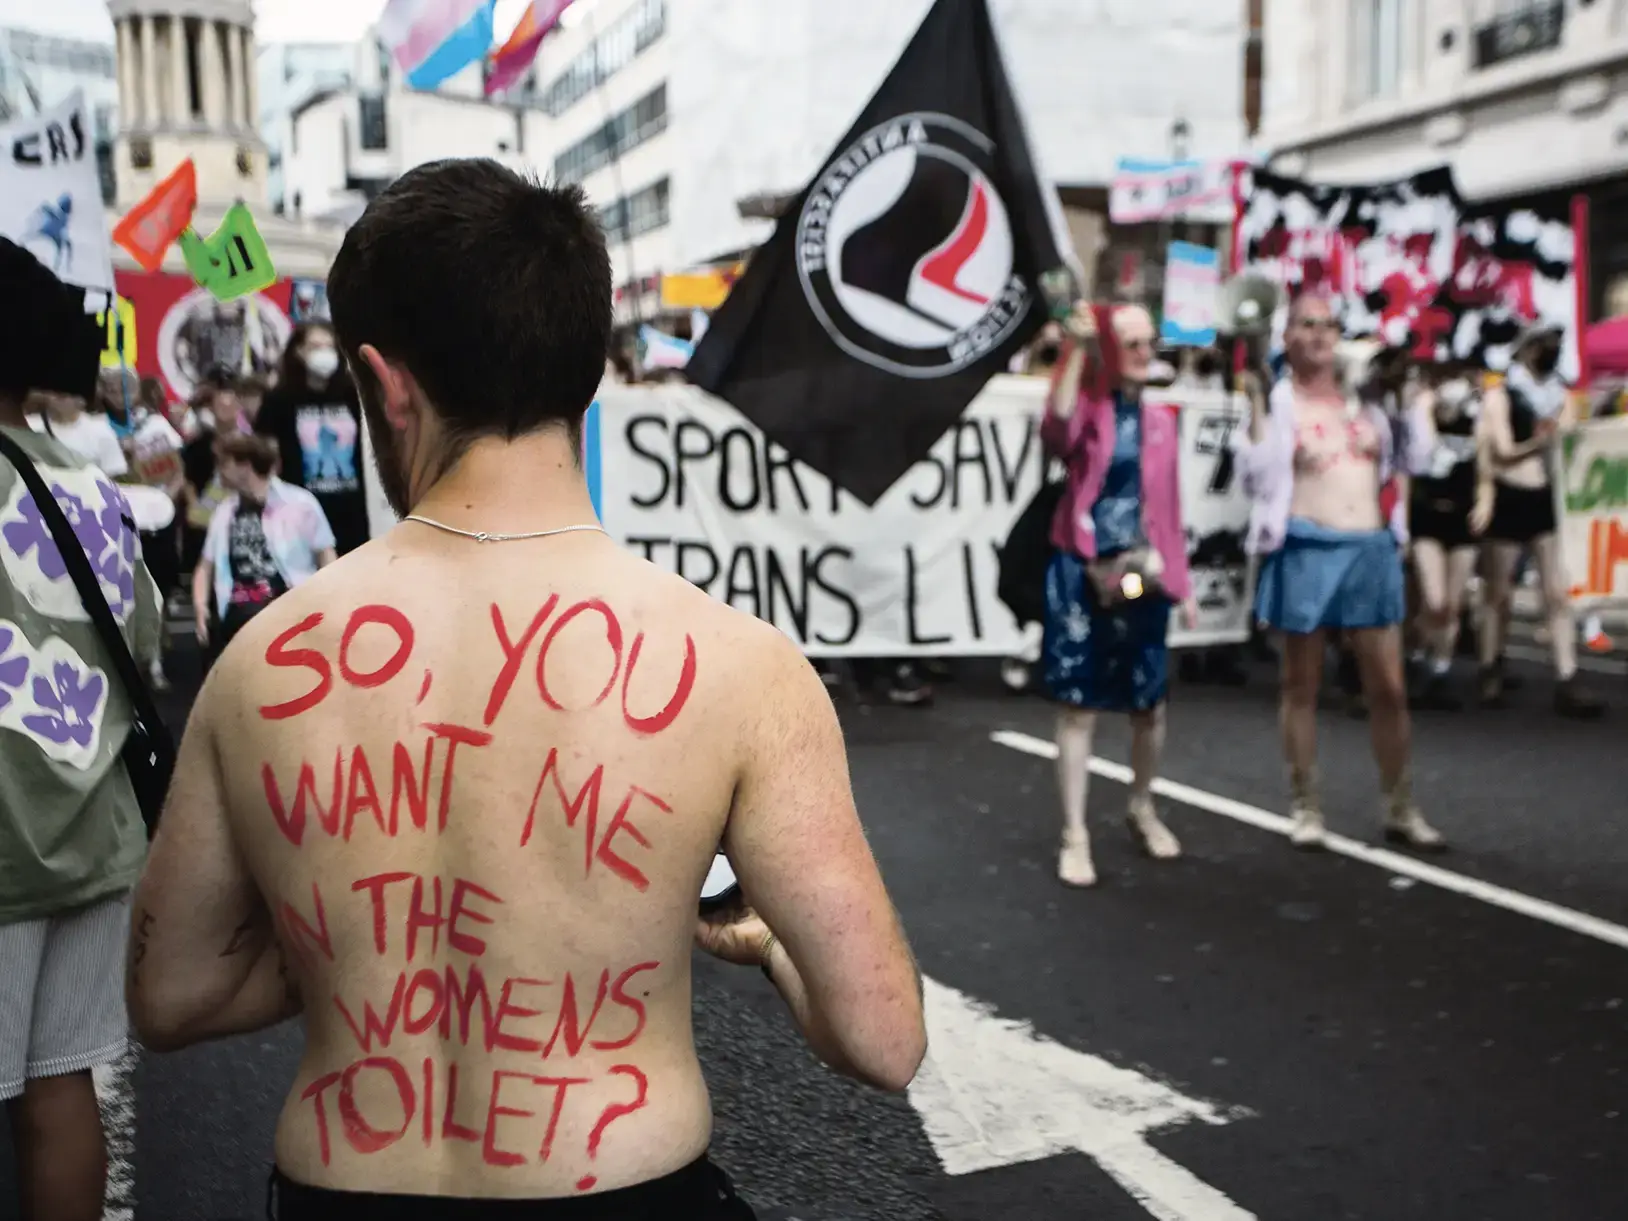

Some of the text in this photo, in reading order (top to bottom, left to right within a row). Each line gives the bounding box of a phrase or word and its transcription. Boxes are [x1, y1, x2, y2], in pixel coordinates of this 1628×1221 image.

[625, 415, 843, 512] SPOR
[626, 536, 1005, 645] TRANS LI
[258, 593, 697, 735] SO, YOU
[261, 722, 674, 892] WANT ME
[276, 871, 504, 966] N THE
[334, 961, 661, 1059] WOMENS
[300, 1056, 648, 1192] TOILET?
